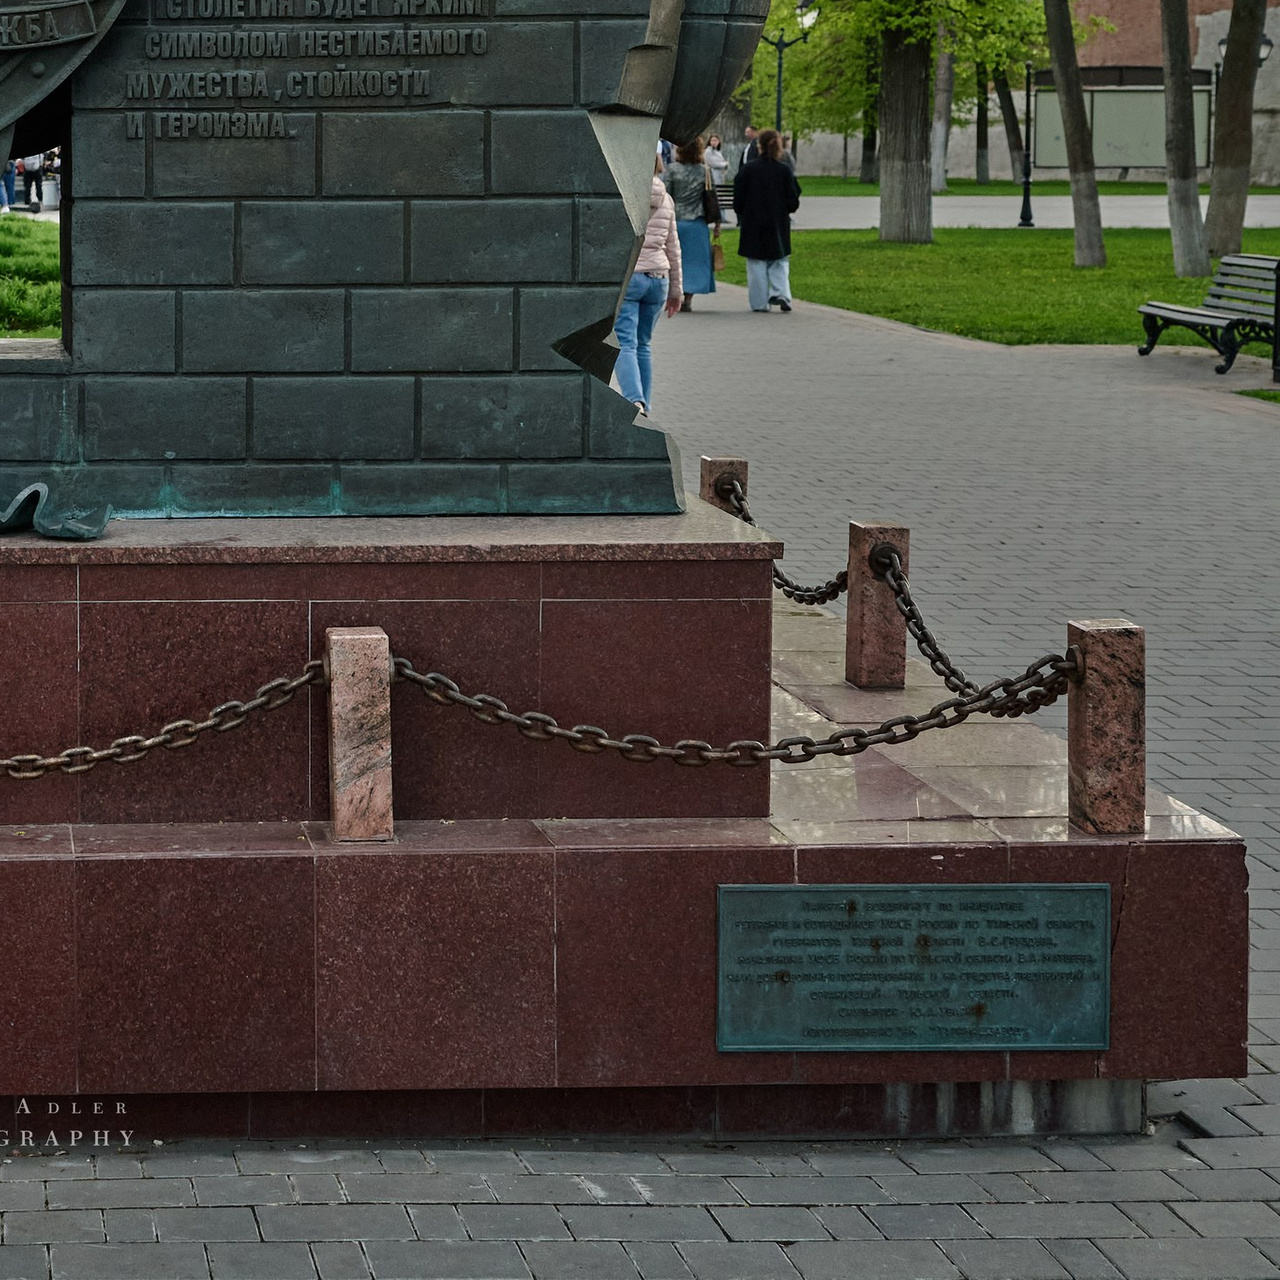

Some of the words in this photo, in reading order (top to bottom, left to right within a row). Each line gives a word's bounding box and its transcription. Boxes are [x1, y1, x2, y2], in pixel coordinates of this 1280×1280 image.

[145, 31, 289, 59] СИМВОЛОМ
[299, 28, 487, 58] НЕСГИБАЕМОГО
[126, 113, 144, 140] И
[154, 111, 296, 139] ГЕРОИЗМА.
